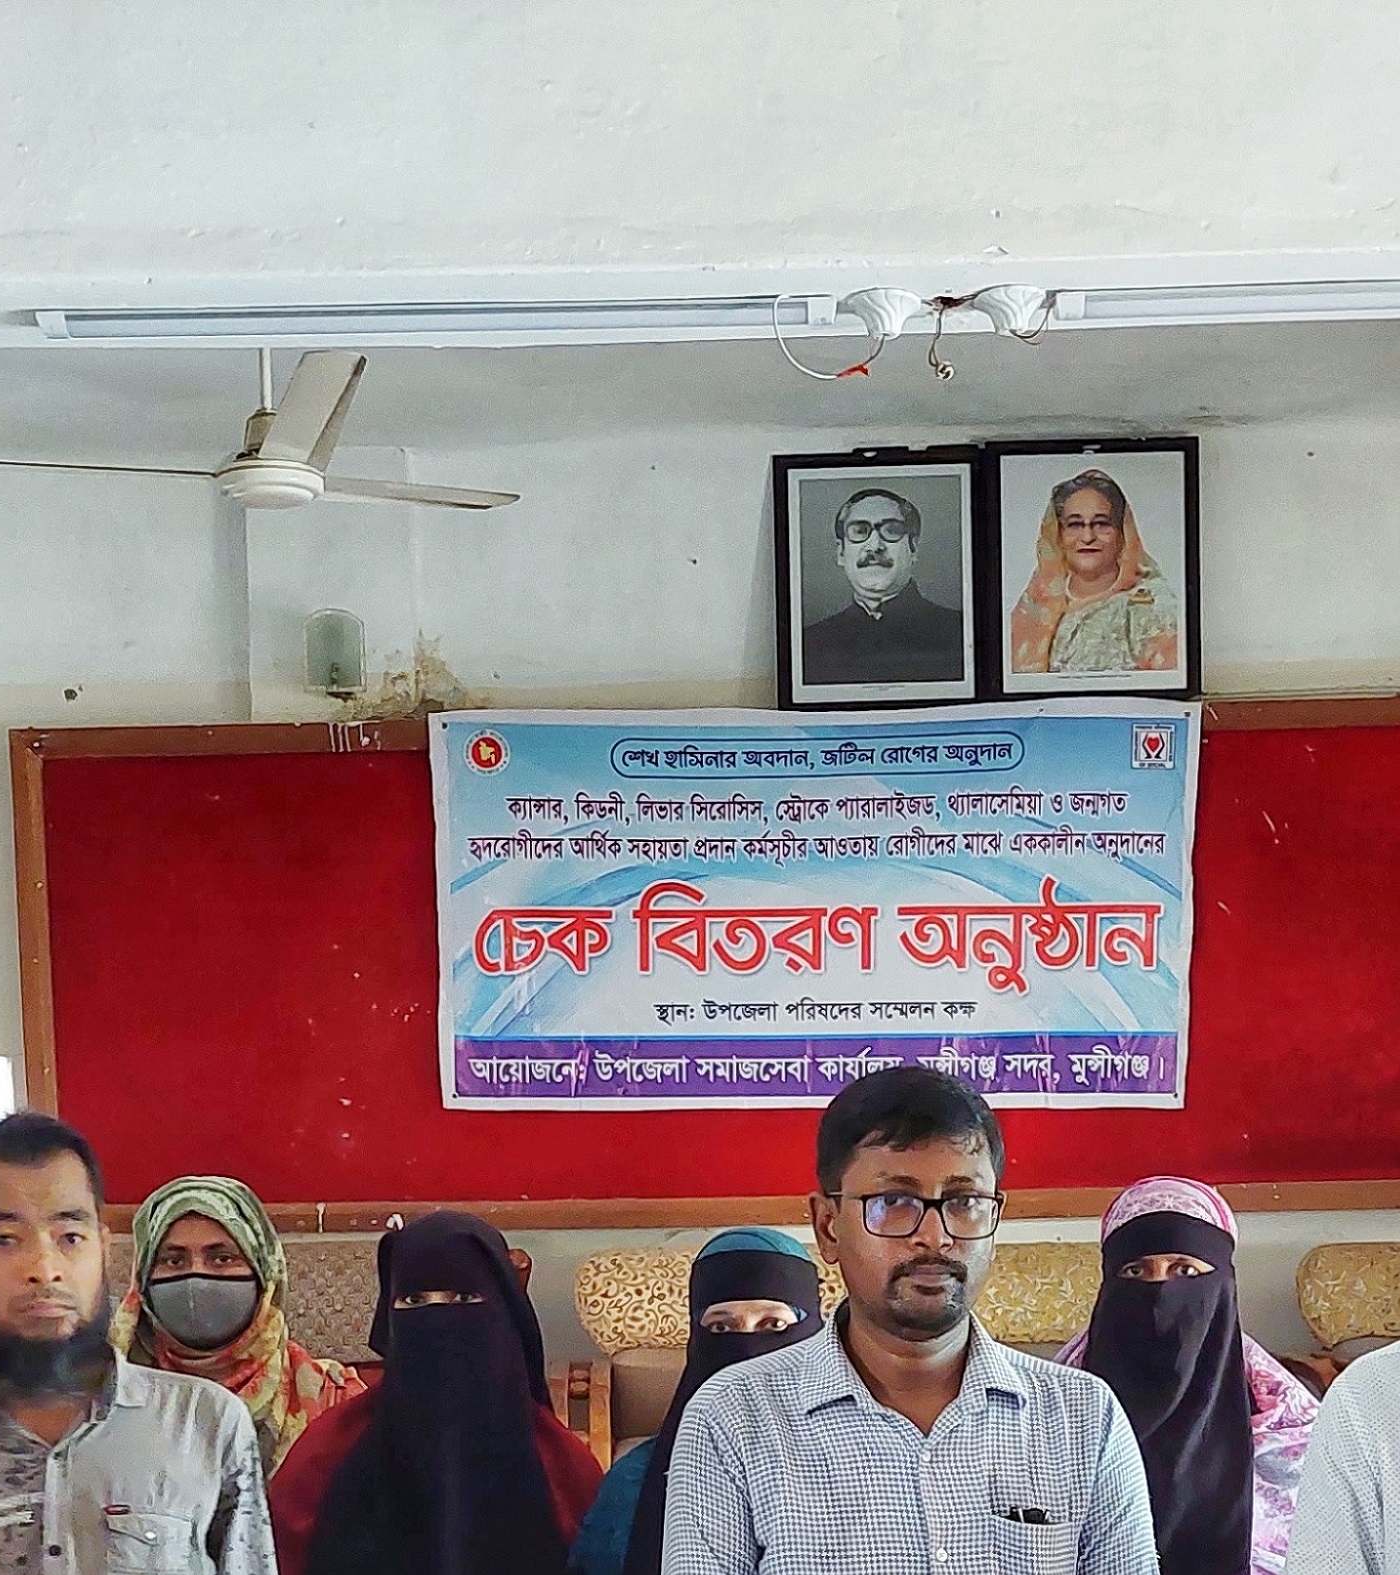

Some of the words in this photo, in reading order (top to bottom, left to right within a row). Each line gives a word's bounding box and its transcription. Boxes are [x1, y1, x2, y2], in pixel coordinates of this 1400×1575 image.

[621, 748, 659, 768] শেখ
[664, 744, 737, 769] হাসিনার
[743, 748, 815, 770] অবদান,
[821, 742, 874, 766] জটিল
[881, 745, 938, 765] রোগের
[944, 742, 1013, 765] অনুদান
[574, 791, 630, 826] কিডনী,
[636, 793, 685, 822] লিভার
[690, 793, 768, 825] সিরোসিস,
[776, 792, 830, 822] স্ট্রোকে
[836, 790, 940, 821] প্যারালাইজড,
[948, 785, 1044, 817] থ্যালাসেমিয়া
[1051, 794, 1063, 813] ও
[1069, 791, 1127, 816] জন্মগত
[569, 830, 623, 860] আর্থিক
[627, 837, 689, 861] সহায়তা
[694, 837, 737, 860] প্রদান
[741, 830, 809, 866] কর্মসূচীর
[813, 834, 880, 858] আওতায়
[886, 827, 957, 856] রোগীদের
[962, 831, 1003, 855] মাঝে
[1009, 826, 1087, 854] এককালীন
[1091, 831, 1166, 860] অনুদানের
[473, 902, 612, 974] চেক
[632, 879, 876, 976] বিতরণ
[898, 876, 1164, 994] অনুষ্ঠান
[654, 1003, 695, 1026] স্থান:
[702, 999, 779, 1022] উপজেলা
[785, 997, 861, 1021] পরিষদের
[869, 1001, 935, 1021] সম্মেলন
[941, 1001, 979, 1020] কক্ষ
[592, 1050, 690, 1085] উপজেলা
[695, 1055, 812, 1085] সমাজসেবা
[1002, 1053, 1061, 1085] সদর,
[1068, 1044, 1150, 1086] মুন্সীগঞ্জ
